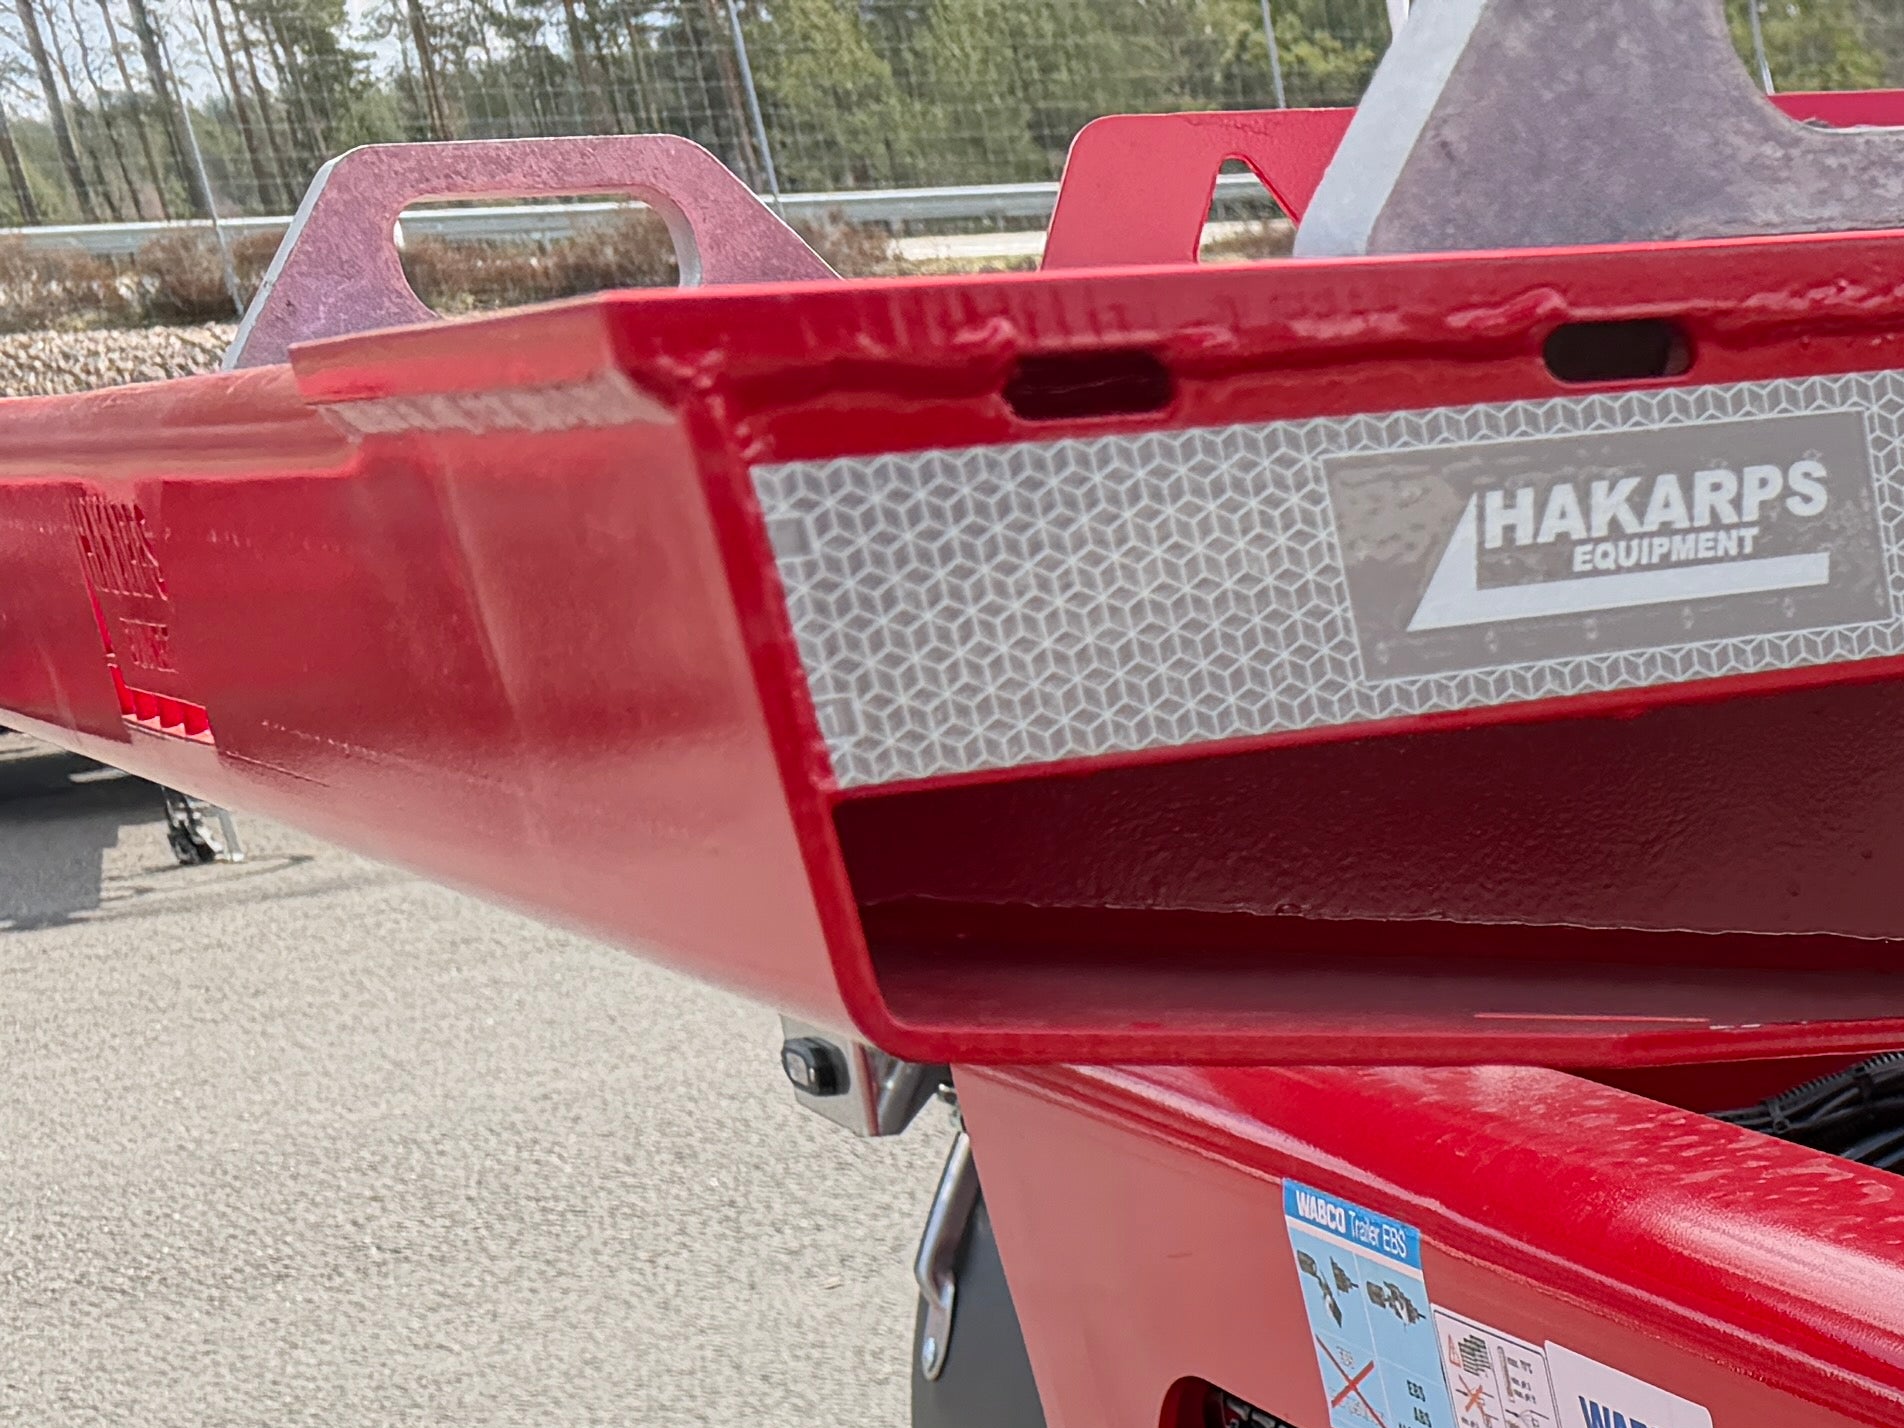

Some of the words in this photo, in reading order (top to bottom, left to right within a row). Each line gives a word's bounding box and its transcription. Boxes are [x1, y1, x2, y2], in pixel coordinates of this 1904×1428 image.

[1483, 460, 1828, 549] HAKARPS
[1572, 526, 1759, 573] EQUIPMENT
[1296, 1189, 1347, 1234] WABCO
[1347, 1210, 1381, 1248] Trailer
[1382, 1223, 1407, 1260] EBS
[1406, 1379, 1426, 1403] EBS
[1413, 1406, 1433, 1428] ABS
